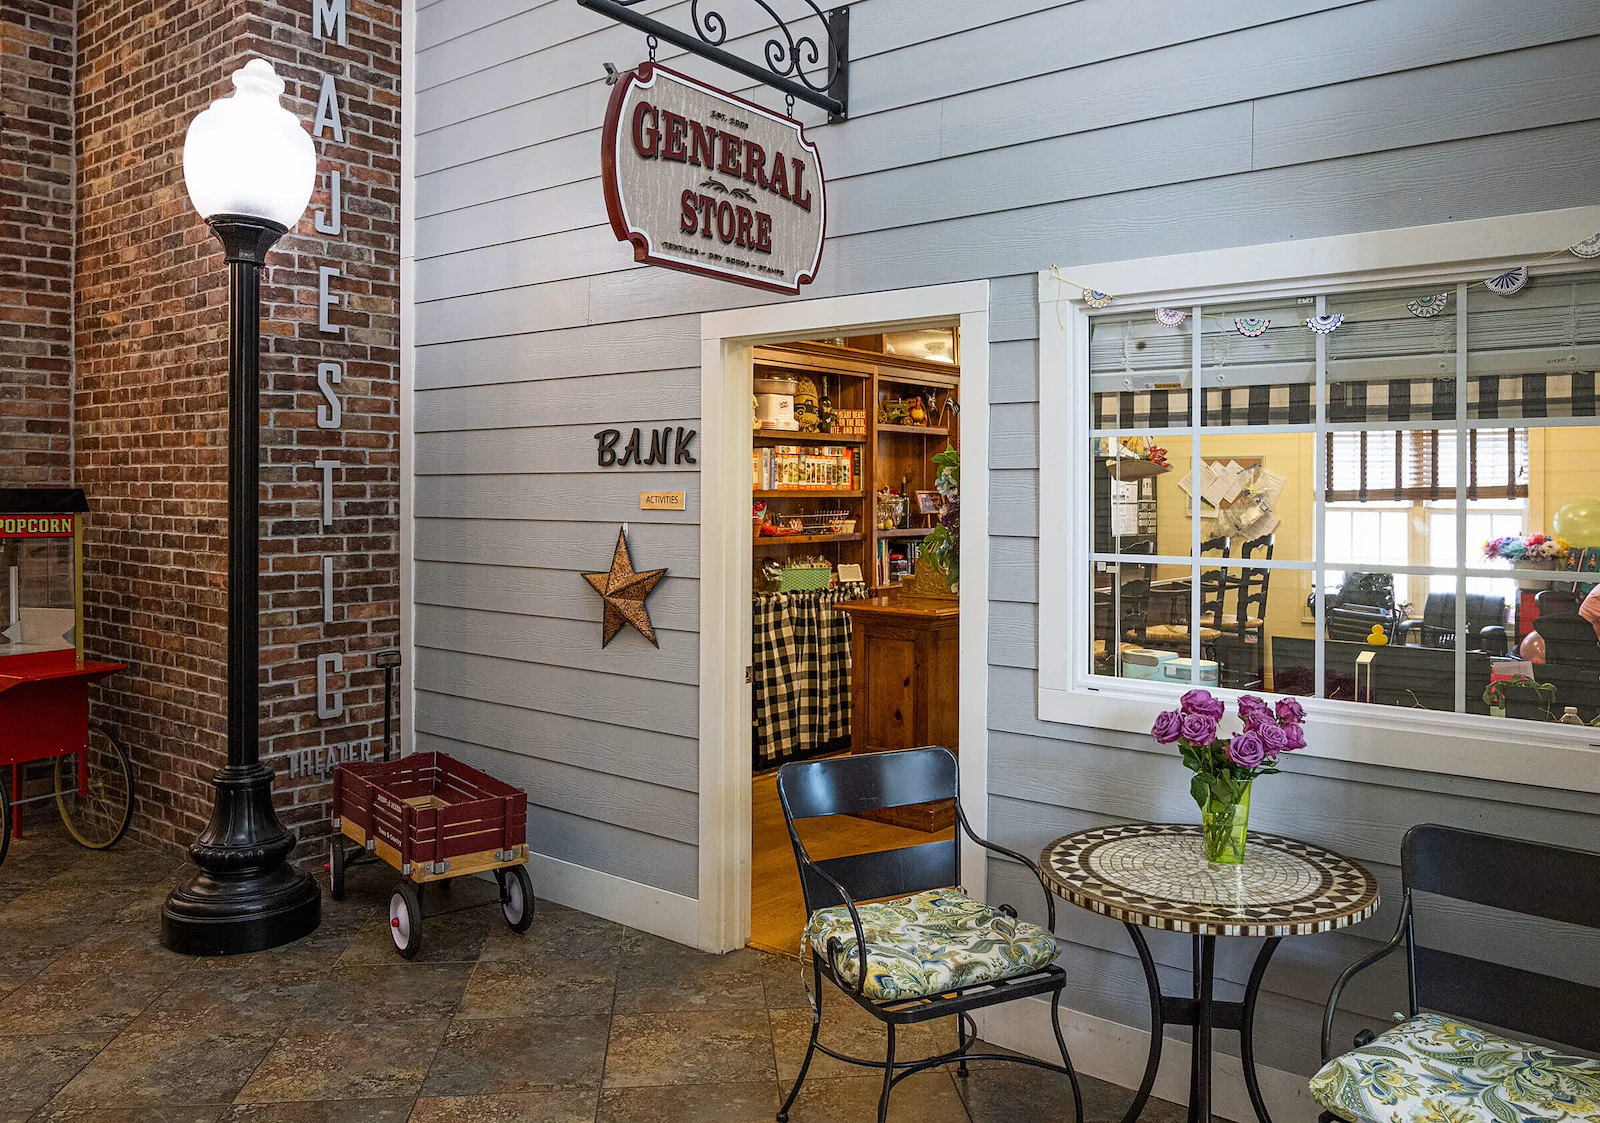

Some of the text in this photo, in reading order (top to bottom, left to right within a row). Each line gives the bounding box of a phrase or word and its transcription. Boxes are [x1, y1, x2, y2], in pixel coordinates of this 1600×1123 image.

[632, 101, 812, 213] GENERAL
[680, 189, 772, 254] STORE
[660, 241, 785, 276] TEXTILES DRY GOODS STAMPS
[312, 0, 347, 719] MAJESTIC
[594, 426, 697, 466] BANK
[645, 495, 679, 504] ACTIVITIES
[287, 740, 373, 778] THEATER
